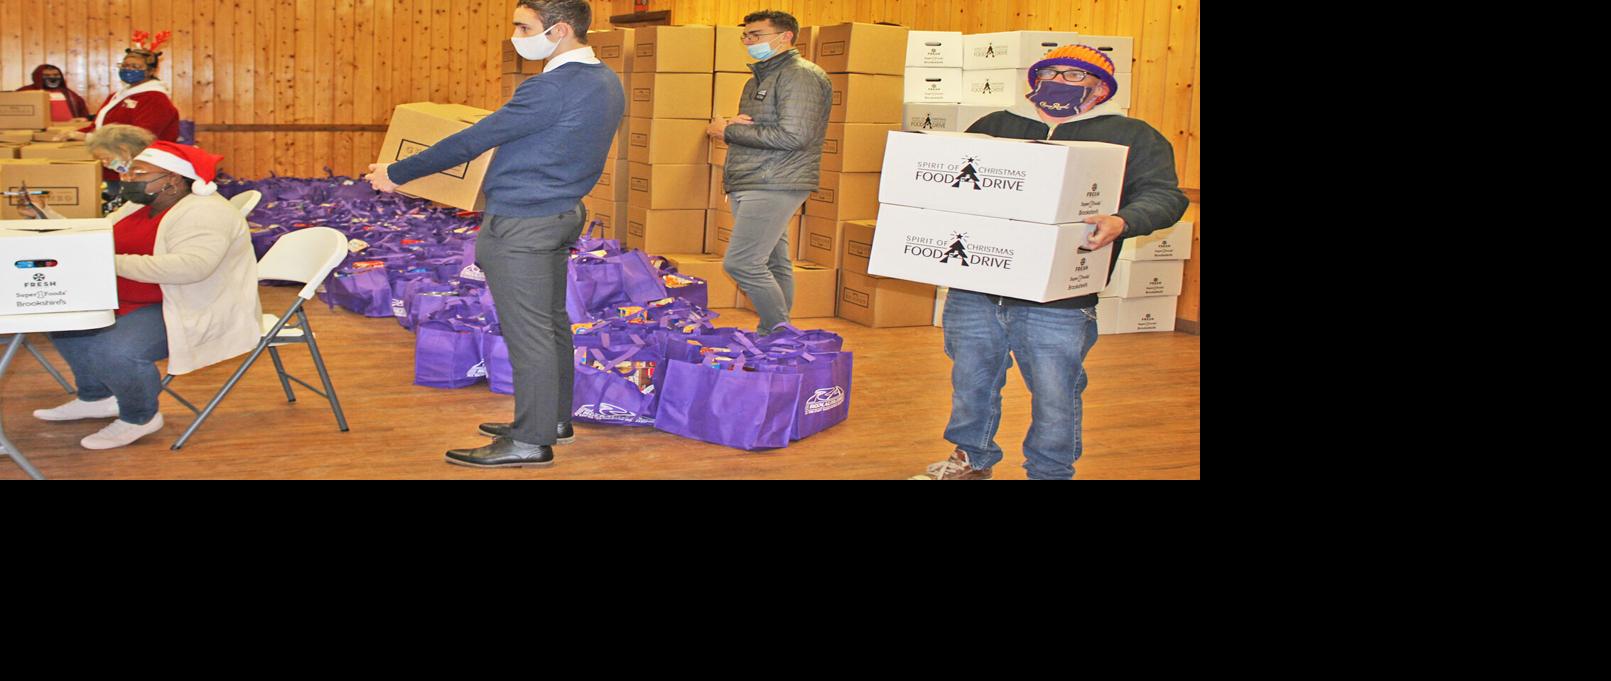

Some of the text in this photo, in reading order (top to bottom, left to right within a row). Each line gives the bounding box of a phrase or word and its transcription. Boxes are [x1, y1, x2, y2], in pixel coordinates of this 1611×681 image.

[917, 161, 1027, 177] SPIRIT OF CHRISTMAS
[915, 170, 1025, 191] FOOD DRIVE
[906, 234, 1015, 256] SPIRIT OF CHRISTMAS
[904, 244, 1013, 270] FOOD DRIVE
